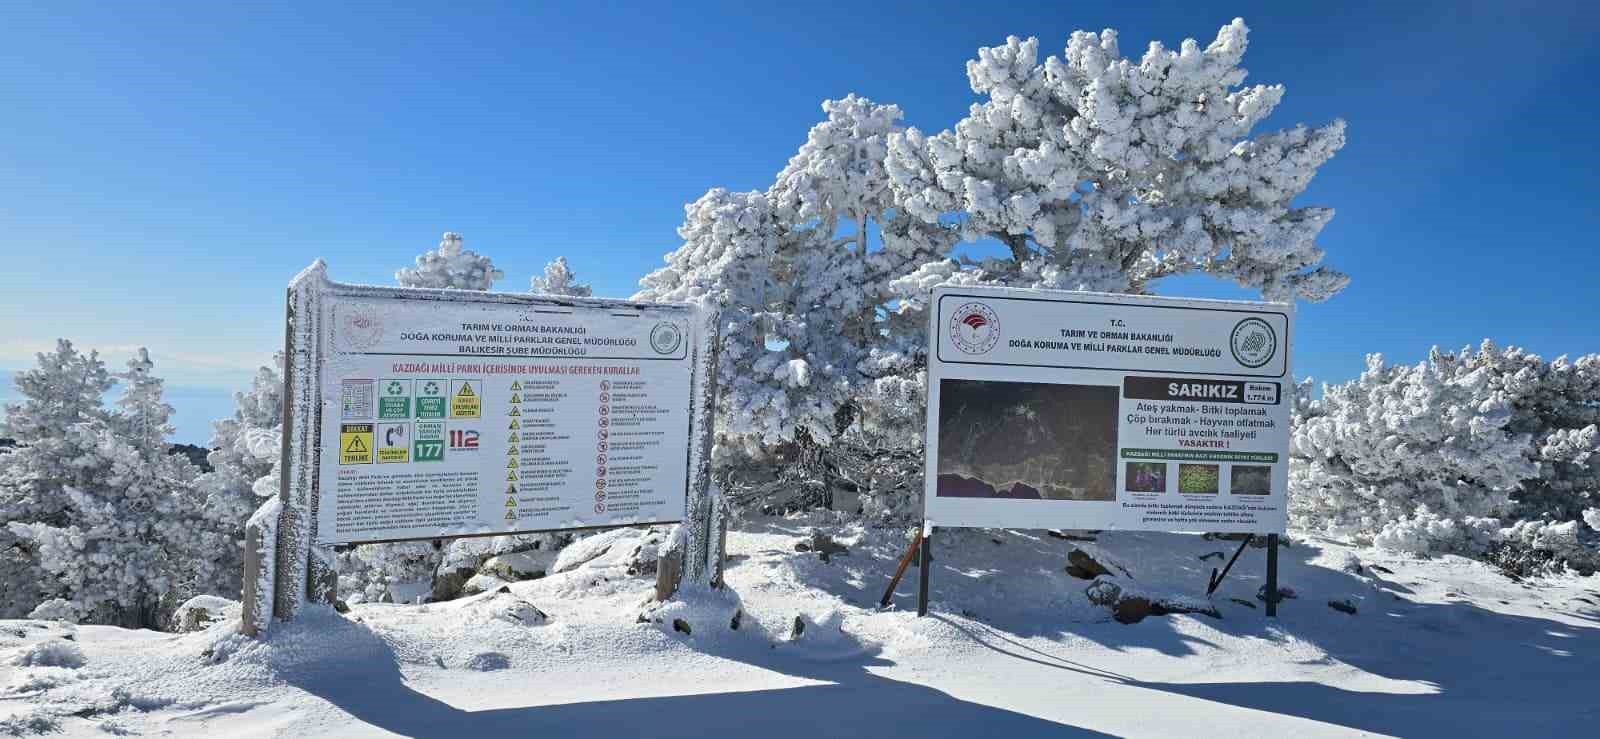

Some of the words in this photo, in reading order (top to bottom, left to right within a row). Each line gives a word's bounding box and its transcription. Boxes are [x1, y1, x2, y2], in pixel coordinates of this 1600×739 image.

[463, 323, 490, 332] TARIM
[491, 324, 505, 332] VE
[505, 324, 539, 333] ORMAN
[1110, 319, 1126, 327] T.C.
[431, 333, 472, 342] KORUMA
[474, 335, 487, 343] VE
[555, 337, 583, 345] GENEL
[1061, 329, 1086, 338] TARIM
[1087, 330, 1098, 339] VE
[1099, 331, 1128, 340] ORMAN
[1130, 332, 1173, 343] BAKANLIĞI
[1009, 338, 1032, 348] DOĞA
[1034, 340, 1069, 350] KORUMA
[1071, 342, 1082, 351] VE
[1106, 344, 1142, 353] PARKLAR
[1144, 346, 1171, 355] GENEL
[457, 364, 481, 374] PARKI
[1168, 383, 1239, 399] SARIKIZ
[1136, 402, 1158, 414] Ateş
[1201, 405, 1223, 415] Bitki
[1225, 407, 1267, 417] toplamak
[1127, 414, 1146, 425] Çöp
[1148, 415, 1191, 425] bırakmak
[1200, 417, 1234, 428] Hayvan
[1236, 419, 1275, 428] otlatmak
[450, 430, 480, 448] 112
[1145, 427, 1162, 436] Her
[1165, 428, 1186, 437] türlü
[1189, 430, 1218, 439] avcılık
[1221, 430, 1257, 440] faaliyeti
[416, 443, 443, 457] 177
[1178, 440, 1225, 449] YASAKTIR
